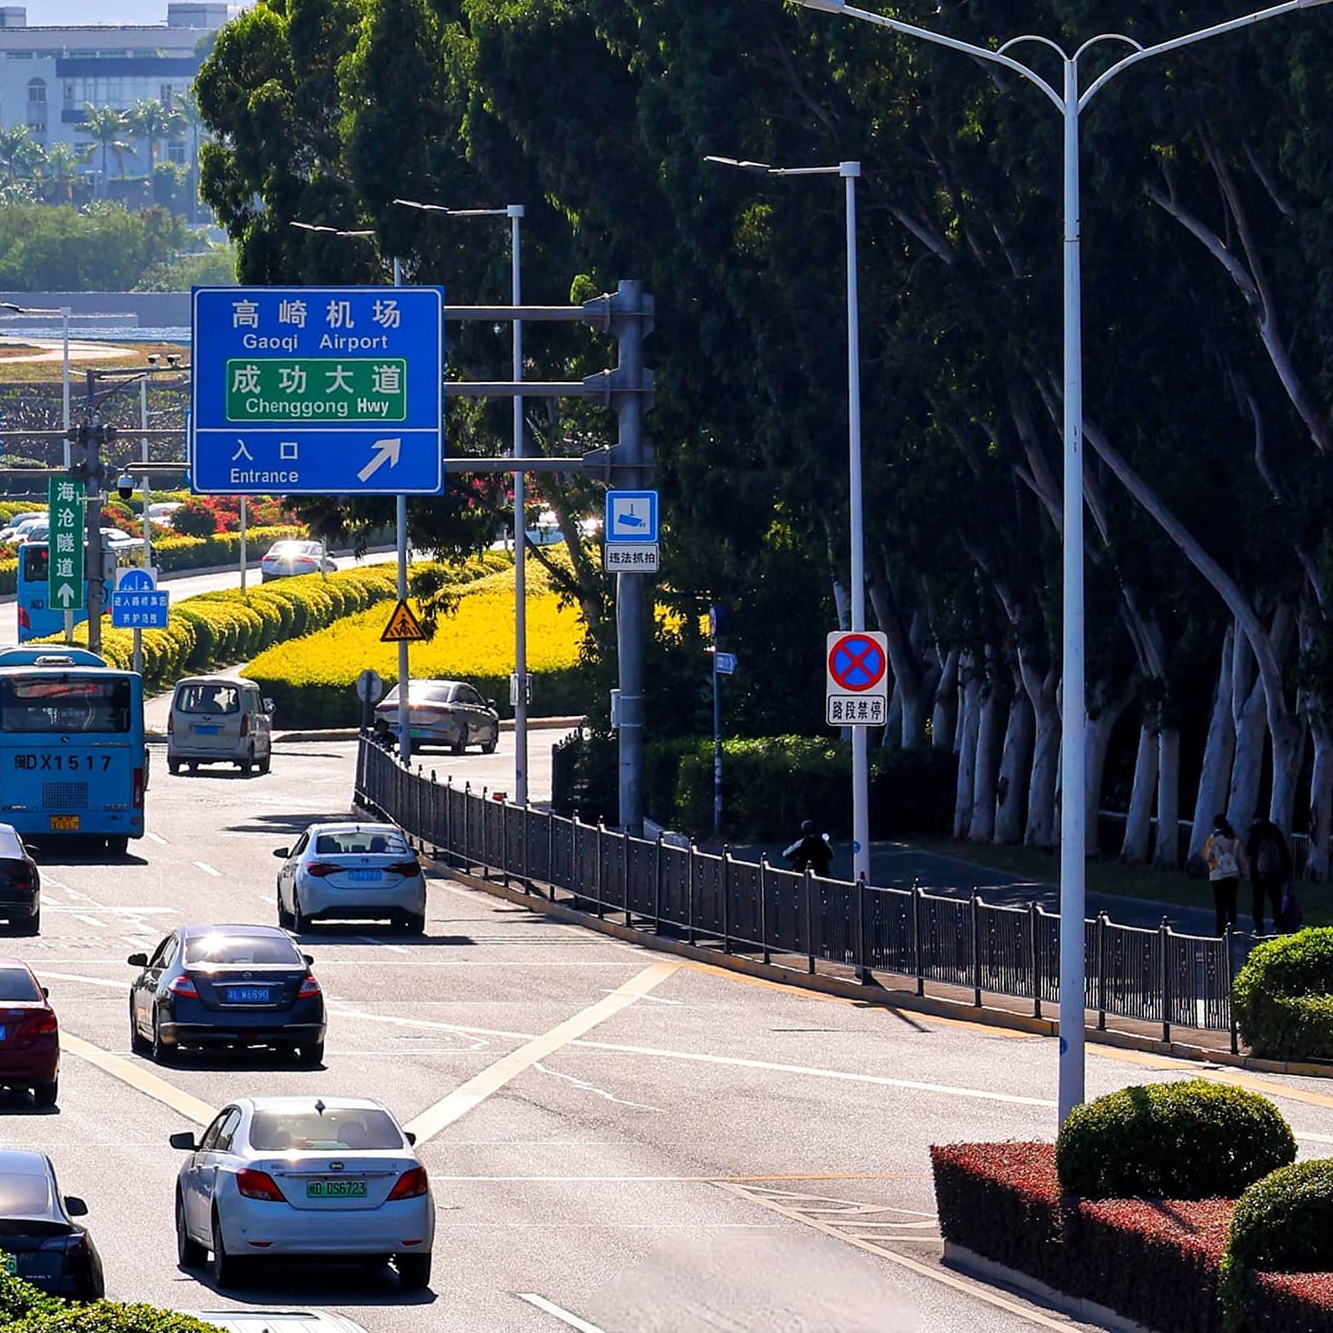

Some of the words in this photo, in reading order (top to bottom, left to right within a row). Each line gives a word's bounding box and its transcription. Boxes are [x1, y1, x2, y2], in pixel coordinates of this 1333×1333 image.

[231, 298, 402, 329] 高崎机场
[242, 334, 299, 352] Gaoqi
[319, 334, 389, 352] Airport
[231, 364, 402, 395] 成功大道
[245, 398, 349, 416] Chenggong
[357, 398, 390, 417] Hwy
[231, 438, 300, 462] 入口
[230, 467, 300, 484] Entrance
[56, 481, 75, 578] 海沧隧道
[609, 552, 655, 564] 违法抓拍
[832, 700, 882, 721] 路段禁停
[14, 753, 112, 771] 闽DX1517
